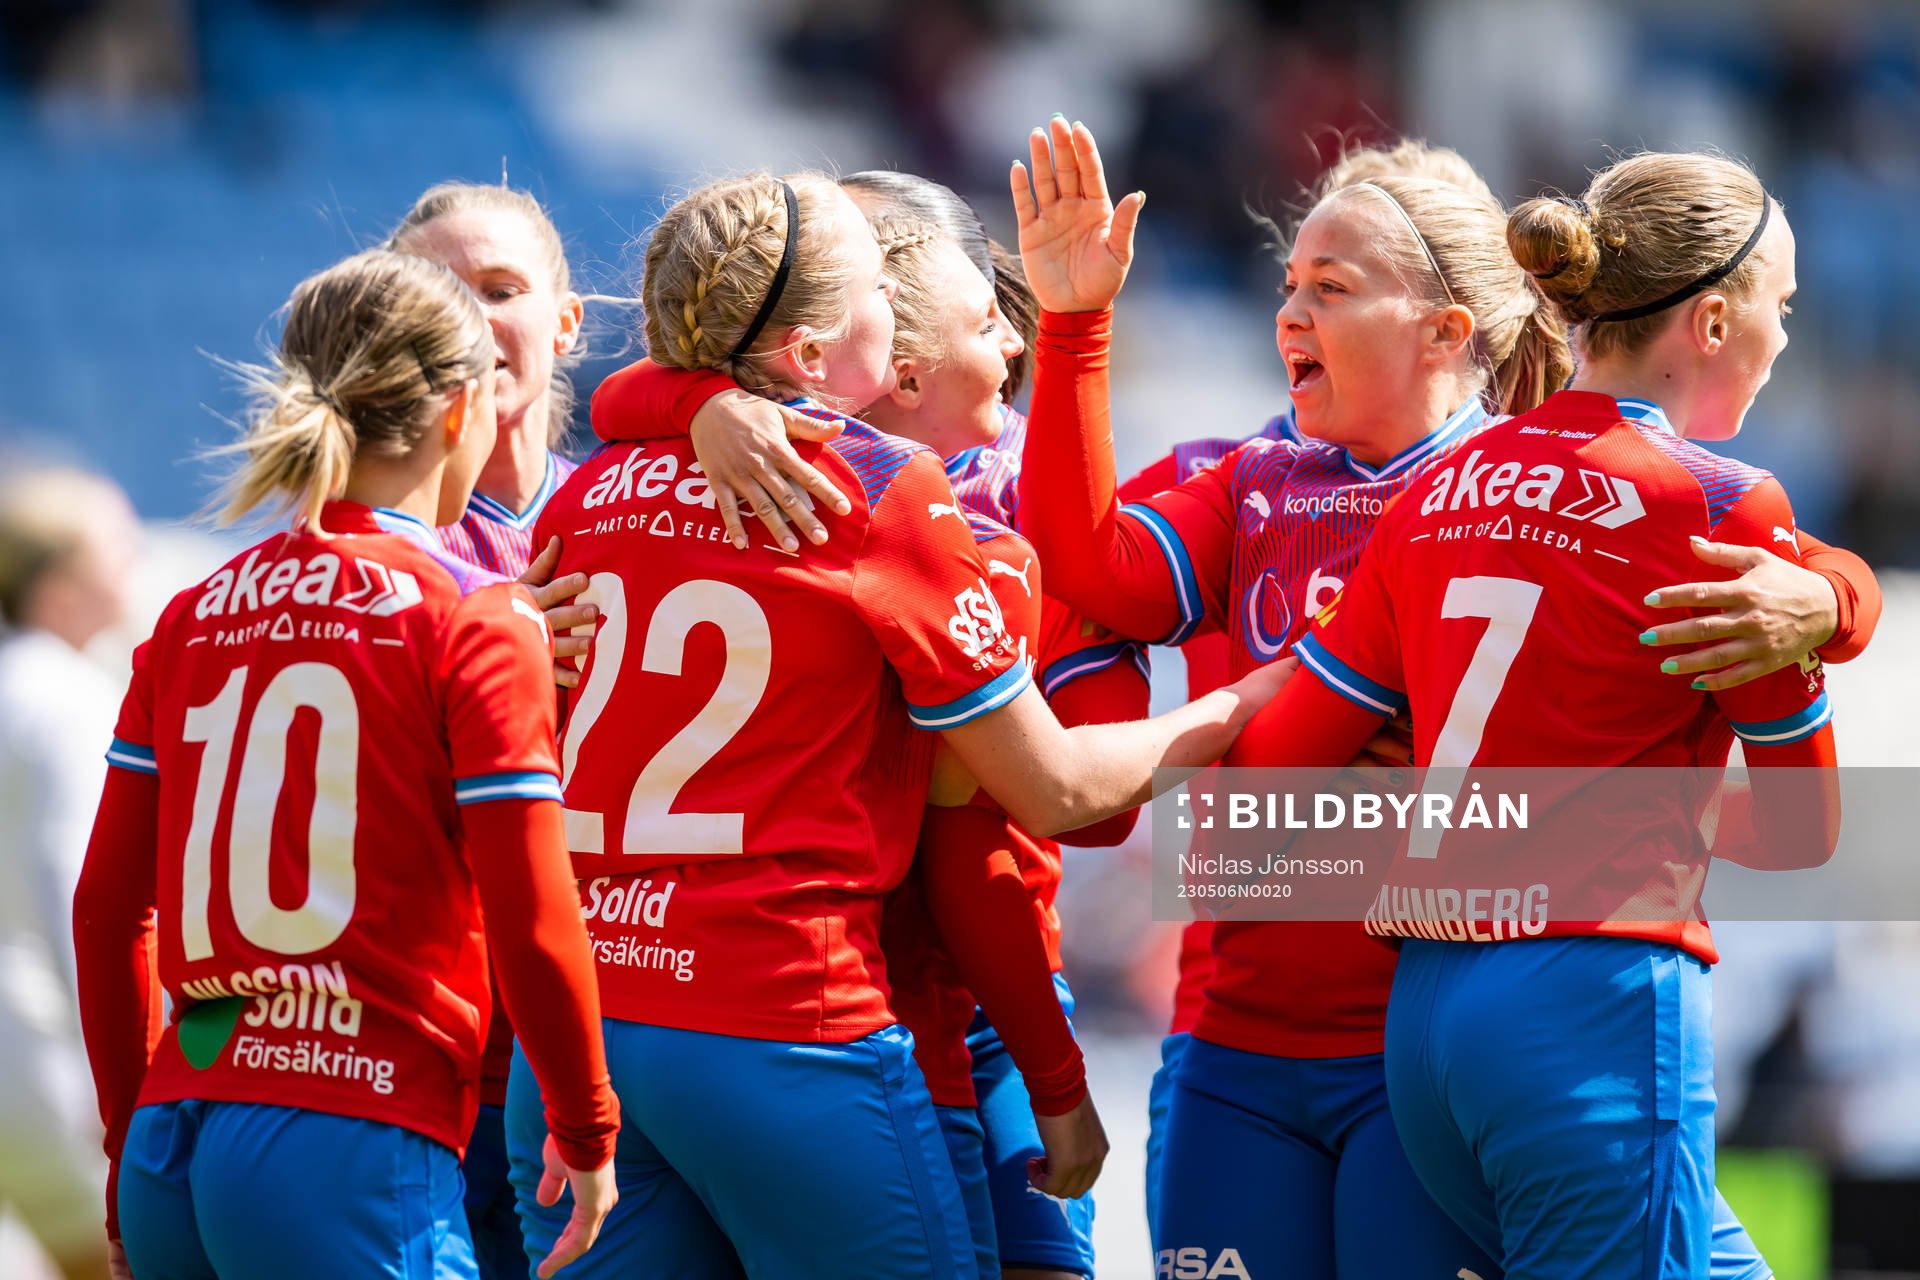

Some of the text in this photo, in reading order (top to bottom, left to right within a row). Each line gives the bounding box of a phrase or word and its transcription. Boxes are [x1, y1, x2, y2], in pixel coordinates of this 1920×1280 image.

[583, 447, 717, 510] akea
[1284, 491, 1388, 515] kondekto
[1421, 449, 1564, 517] akea
[594, 516, 623, 535] PART
[627, 514, 647, 529] OF
[1437, 521, 1581, 554] PART OF ELEDA
[195, 549, 341, 621] akea
[215, 620, 359, 647] PART OF ELEDA
[562, 571, 772, 854] 22
[1407, 575, 1543, 858] 7
[182, 661, 359, 962] 10
[580, 876, 676, 928] Solid
[588, 932, 695, 981] rsäkring
[233, 1035, 395, 1095] Försäkring
